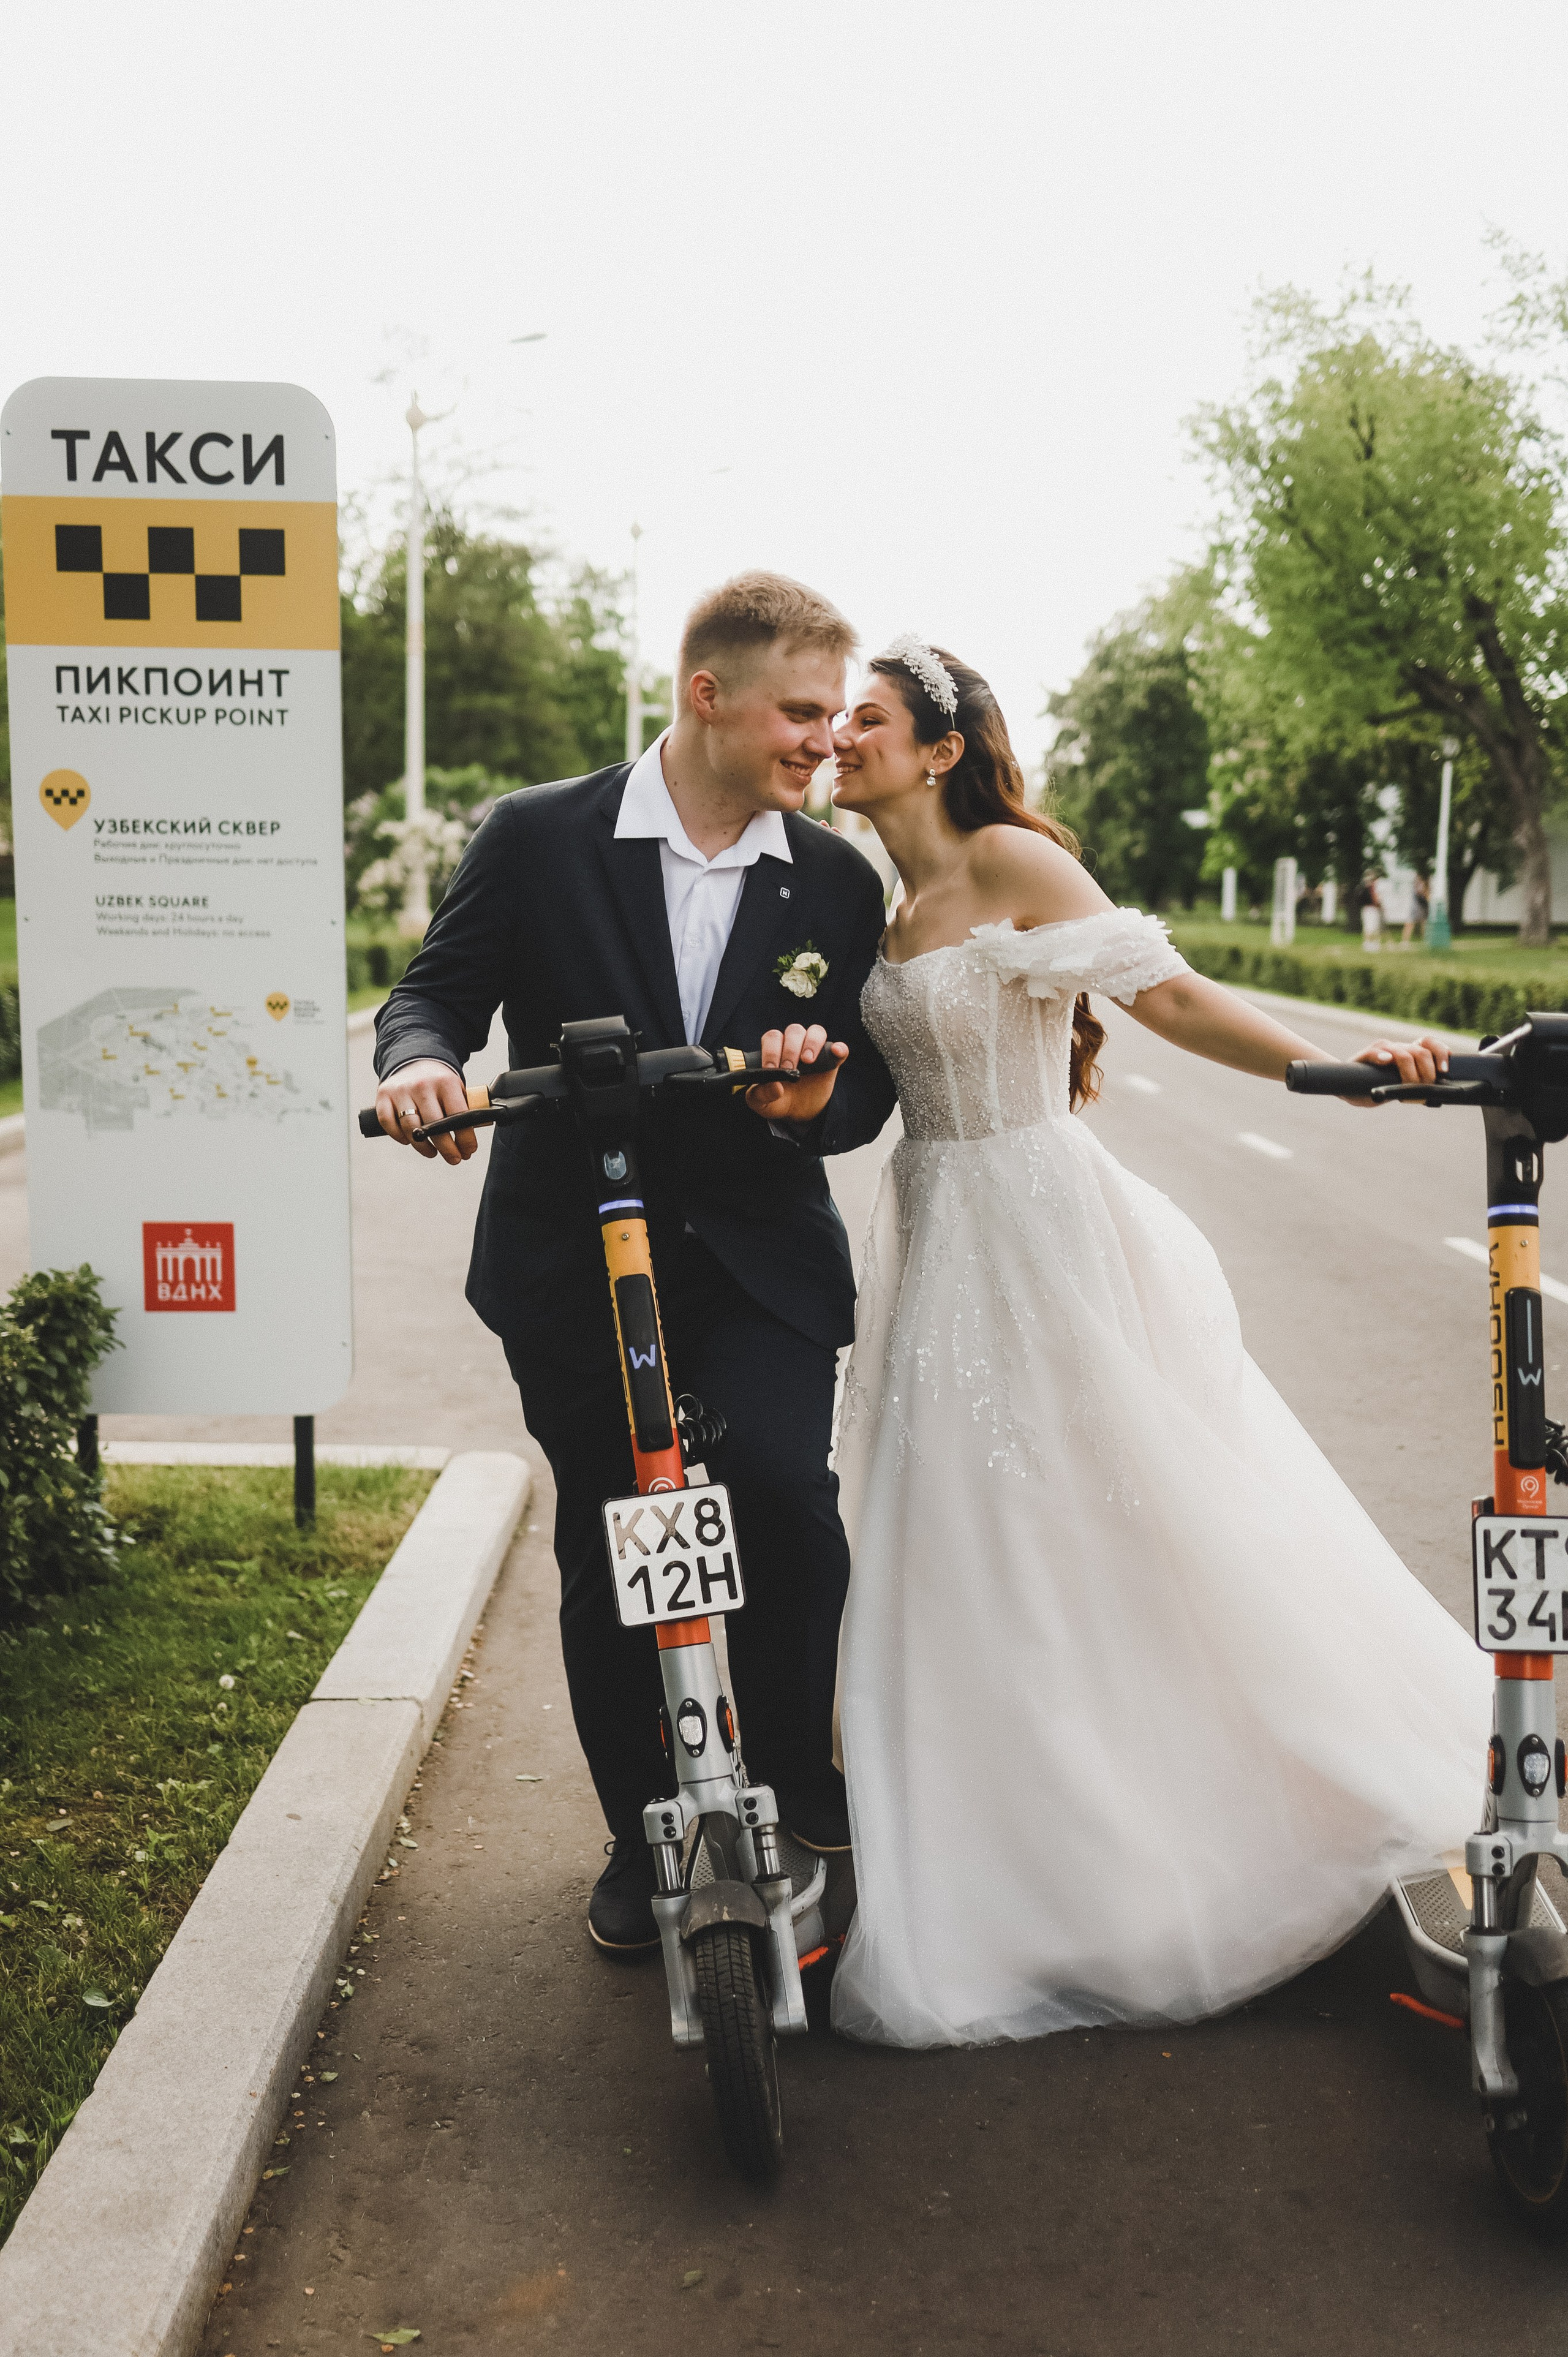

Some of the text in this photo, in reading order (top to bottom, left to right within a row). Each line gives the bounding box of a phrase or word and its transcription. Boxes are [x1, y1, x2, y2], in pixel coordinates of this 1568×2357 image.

[51, 429, 285, 486] ТАКСИ
[56, 665, 290, 697] ПИКПОИНТ
[56, 706, 289, 726] TAXI PICKUP POINT
[94, 817, 281, 835] УЗБЕКСКИЙ СКВЕР
[96, 896, 209, 907] UZBEK SQUARE
[157, 1281, 222, 1302] ВДНХ
[1487, 1588, 1568, 1643] 34
